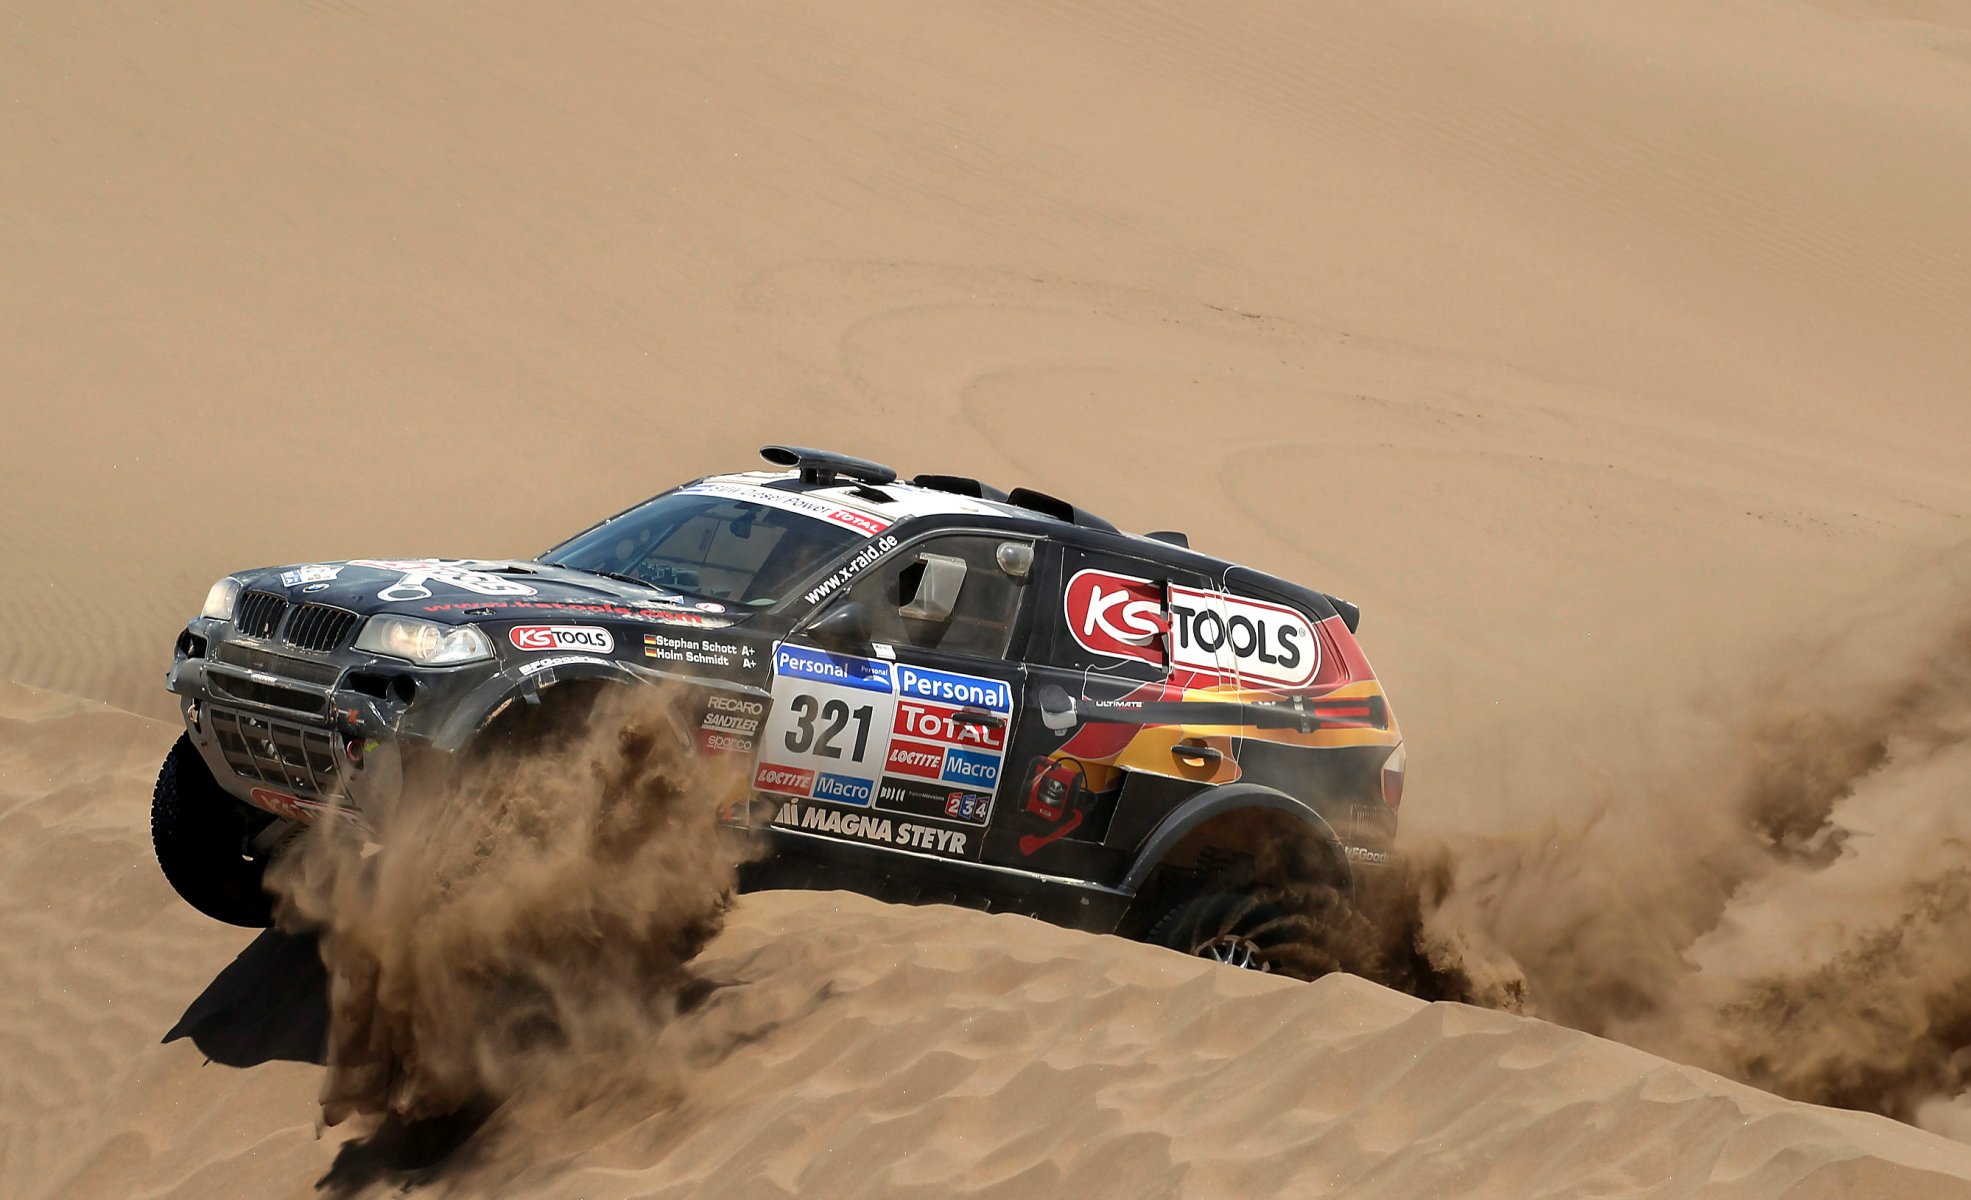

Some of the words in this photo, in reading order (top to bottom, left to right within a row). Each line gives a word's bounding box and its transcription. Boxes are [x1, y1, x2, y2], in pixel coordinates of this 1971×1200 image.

[783, 496, 832, 514] Power
[834, 510, 879, 533] TOTAL
[804, 534, 898, 605] www.x-raid.de
[551, 631, 607, 647] TOOLS
[656, 635, 700, 650] Stephan
[701, 640, 738, 655] Schott
[741, 645, 756, 656] A+
[1170, 603, 1301, 669] TOOLS
[656, 648, 683, 661] Holm
[685, 651, 730, 666] Schmidt
[742, 658, 757, 669] A+
[779, 652, 848, 679] Personal
[860, 665, 889, 677] Personal
[902, 670, 1004, 708] Personal
[707, 695, 763, 715] RECARO
[1095, 700, 1143, 708] ULTIMATE
[703, 713, 759, 731] SANDTLER
[784, 694, 874, 764] 321
[708, 735, 752, 750] sparco
[889, 749, 941, 769] LOCTITE
[946, 756, 996, 779] Macro
[757, 769, 811, 788] LOCTITE
[817, 777, 869, 799] Macro
[948, 798, 960, 814] 2
[962, 800, 975, 815] 3
[975, 802, 987, 818] 4
[801, 806, 892, 842] MAGNA
[895, 823, 967, 854] STEYR
